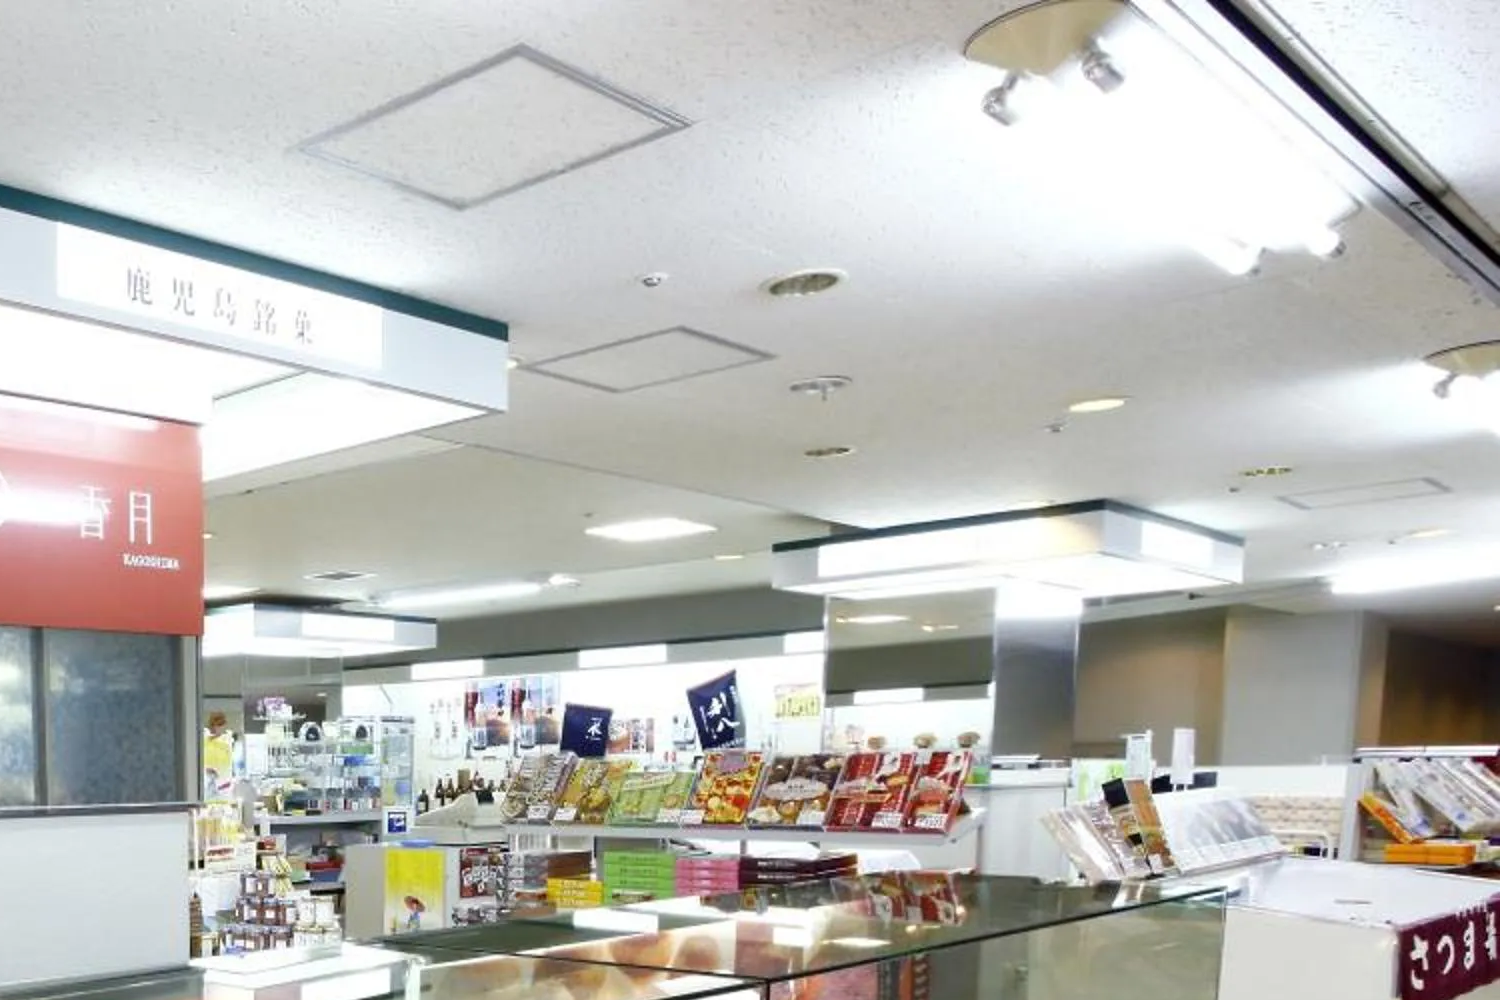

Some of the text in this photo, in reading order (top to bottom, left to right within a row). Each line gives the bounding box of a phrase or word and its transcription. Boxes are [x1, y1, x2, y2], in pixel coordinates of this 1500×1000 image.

[125, 264, 315, 345] 鹿児島銘菓
[79, 486, 152, 544] 香月
